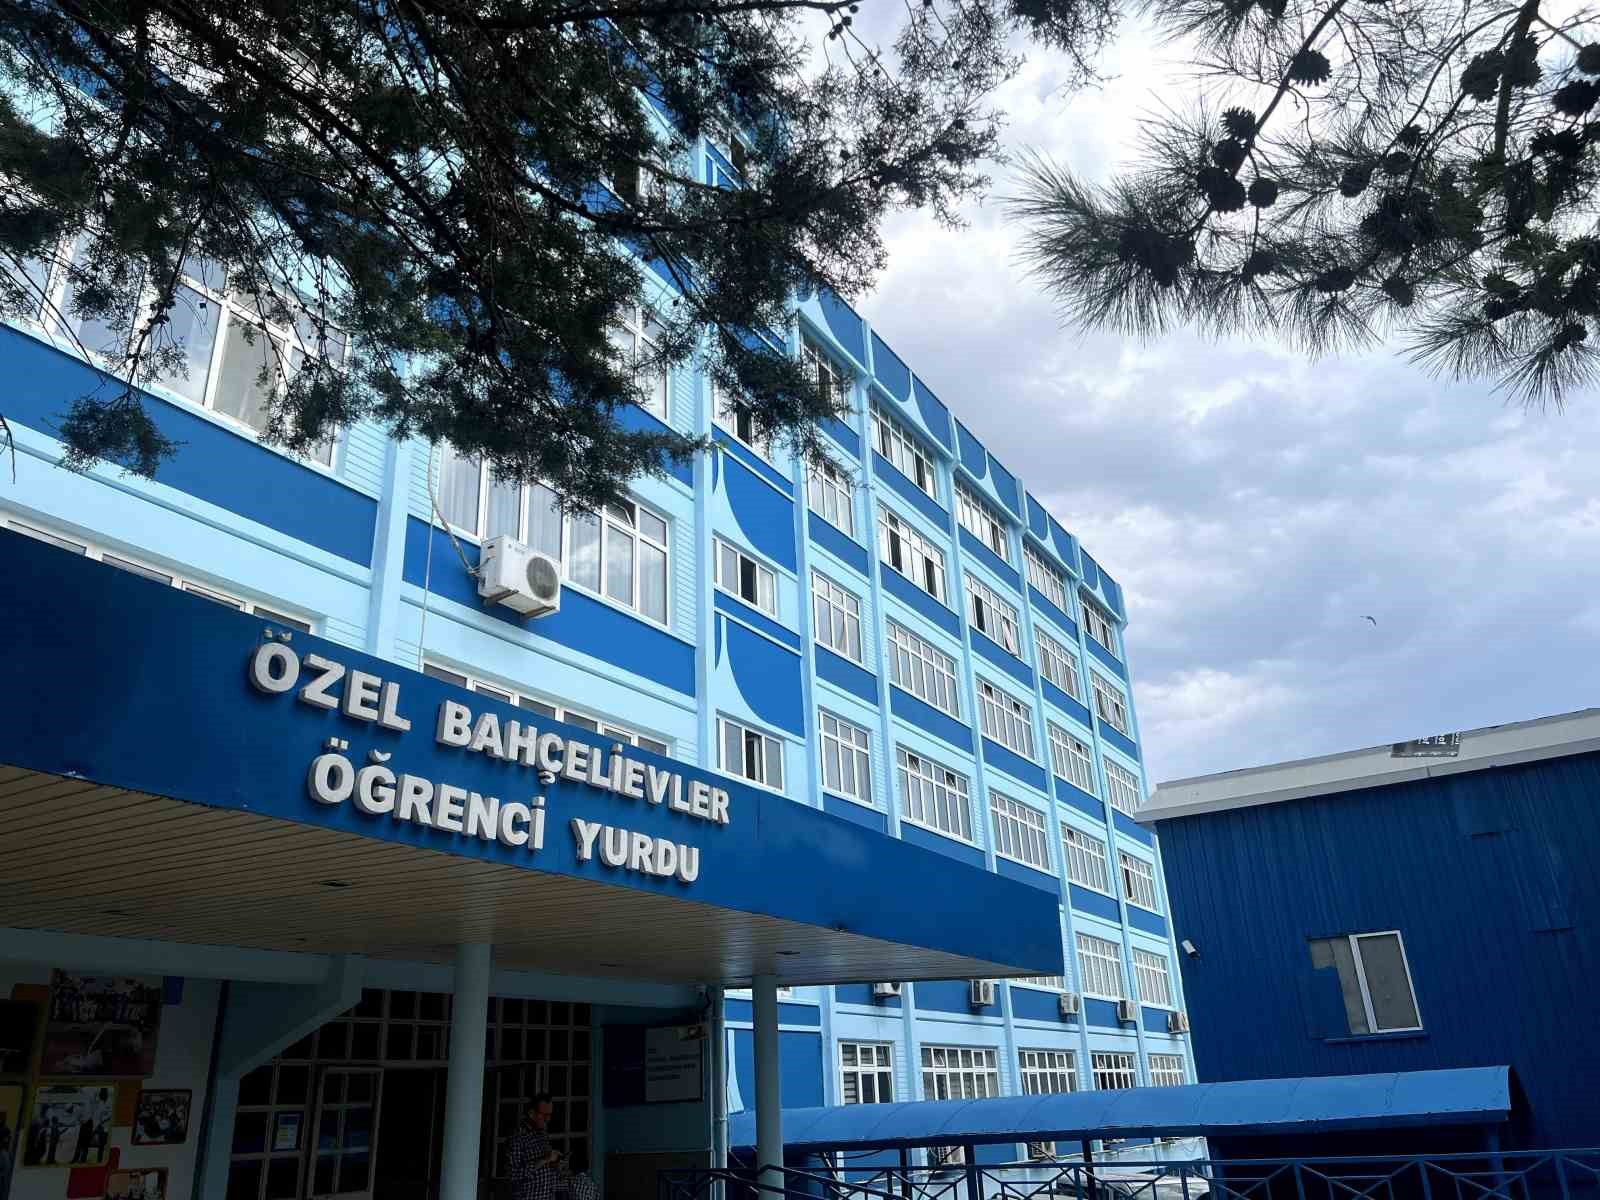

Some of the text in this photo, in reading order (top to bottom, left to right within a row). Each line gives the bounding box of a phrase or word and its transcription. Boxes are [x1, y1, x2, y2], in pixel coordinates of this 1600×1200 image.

[250, 629, 730, 825] ÖZEL BAHÇELİEVLER
[308, 737, 699, 882] ÖĞRENCİ YURDU
